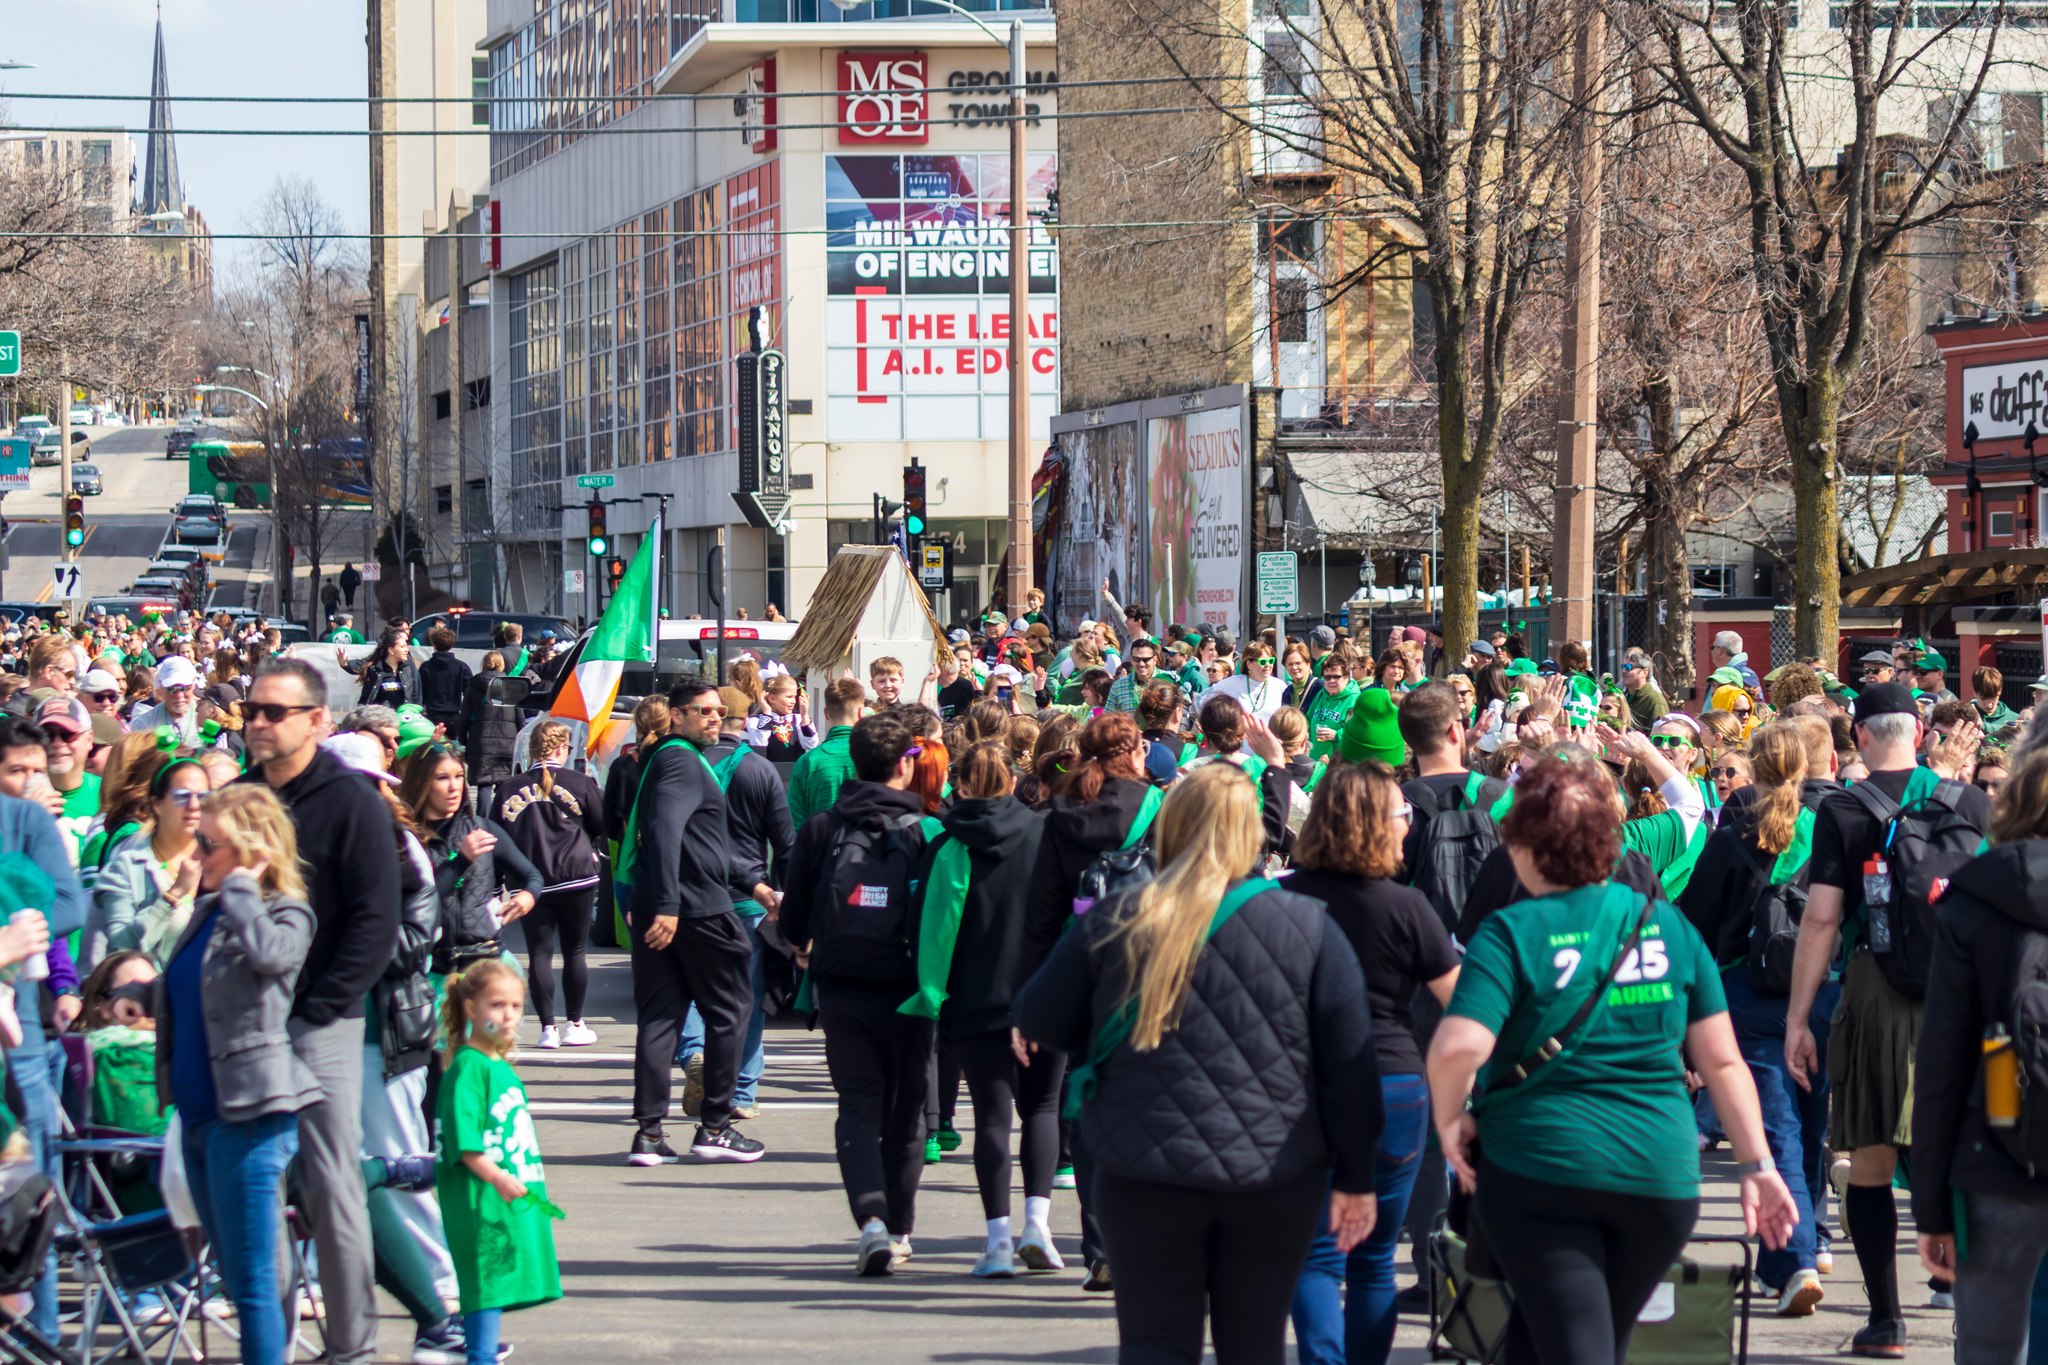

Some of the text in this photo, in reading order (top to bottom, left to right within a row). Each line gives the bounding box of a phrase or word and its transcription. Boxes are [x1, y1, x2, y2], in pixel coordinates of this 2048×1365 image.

[948, 71, 1058, 95] GROMA
[948, 103, 1041, 128] TOWR
[855, 219, 1056, 246] MILWAUKE
[855, 252, 1056, 278] OF ENGINE
[881, 314, 955, 340] THE
[882, 348, 1056, 375] A.I. EDC
[1970, 392, 1984, 415] 165
[1189, 428, 1240, 473] SENDIK'S
[0, 474, 30, 482] THINK
[583, 477, 607, 486] WATER
[1190, 524, 1240, 560] DELIVERED
[1261, 557, 1267, 567] 2
[1263, 581, 1269, 591] 2
[860, 891, 888, 900] IRISH
[860, 898, 888, 908] DANCE
